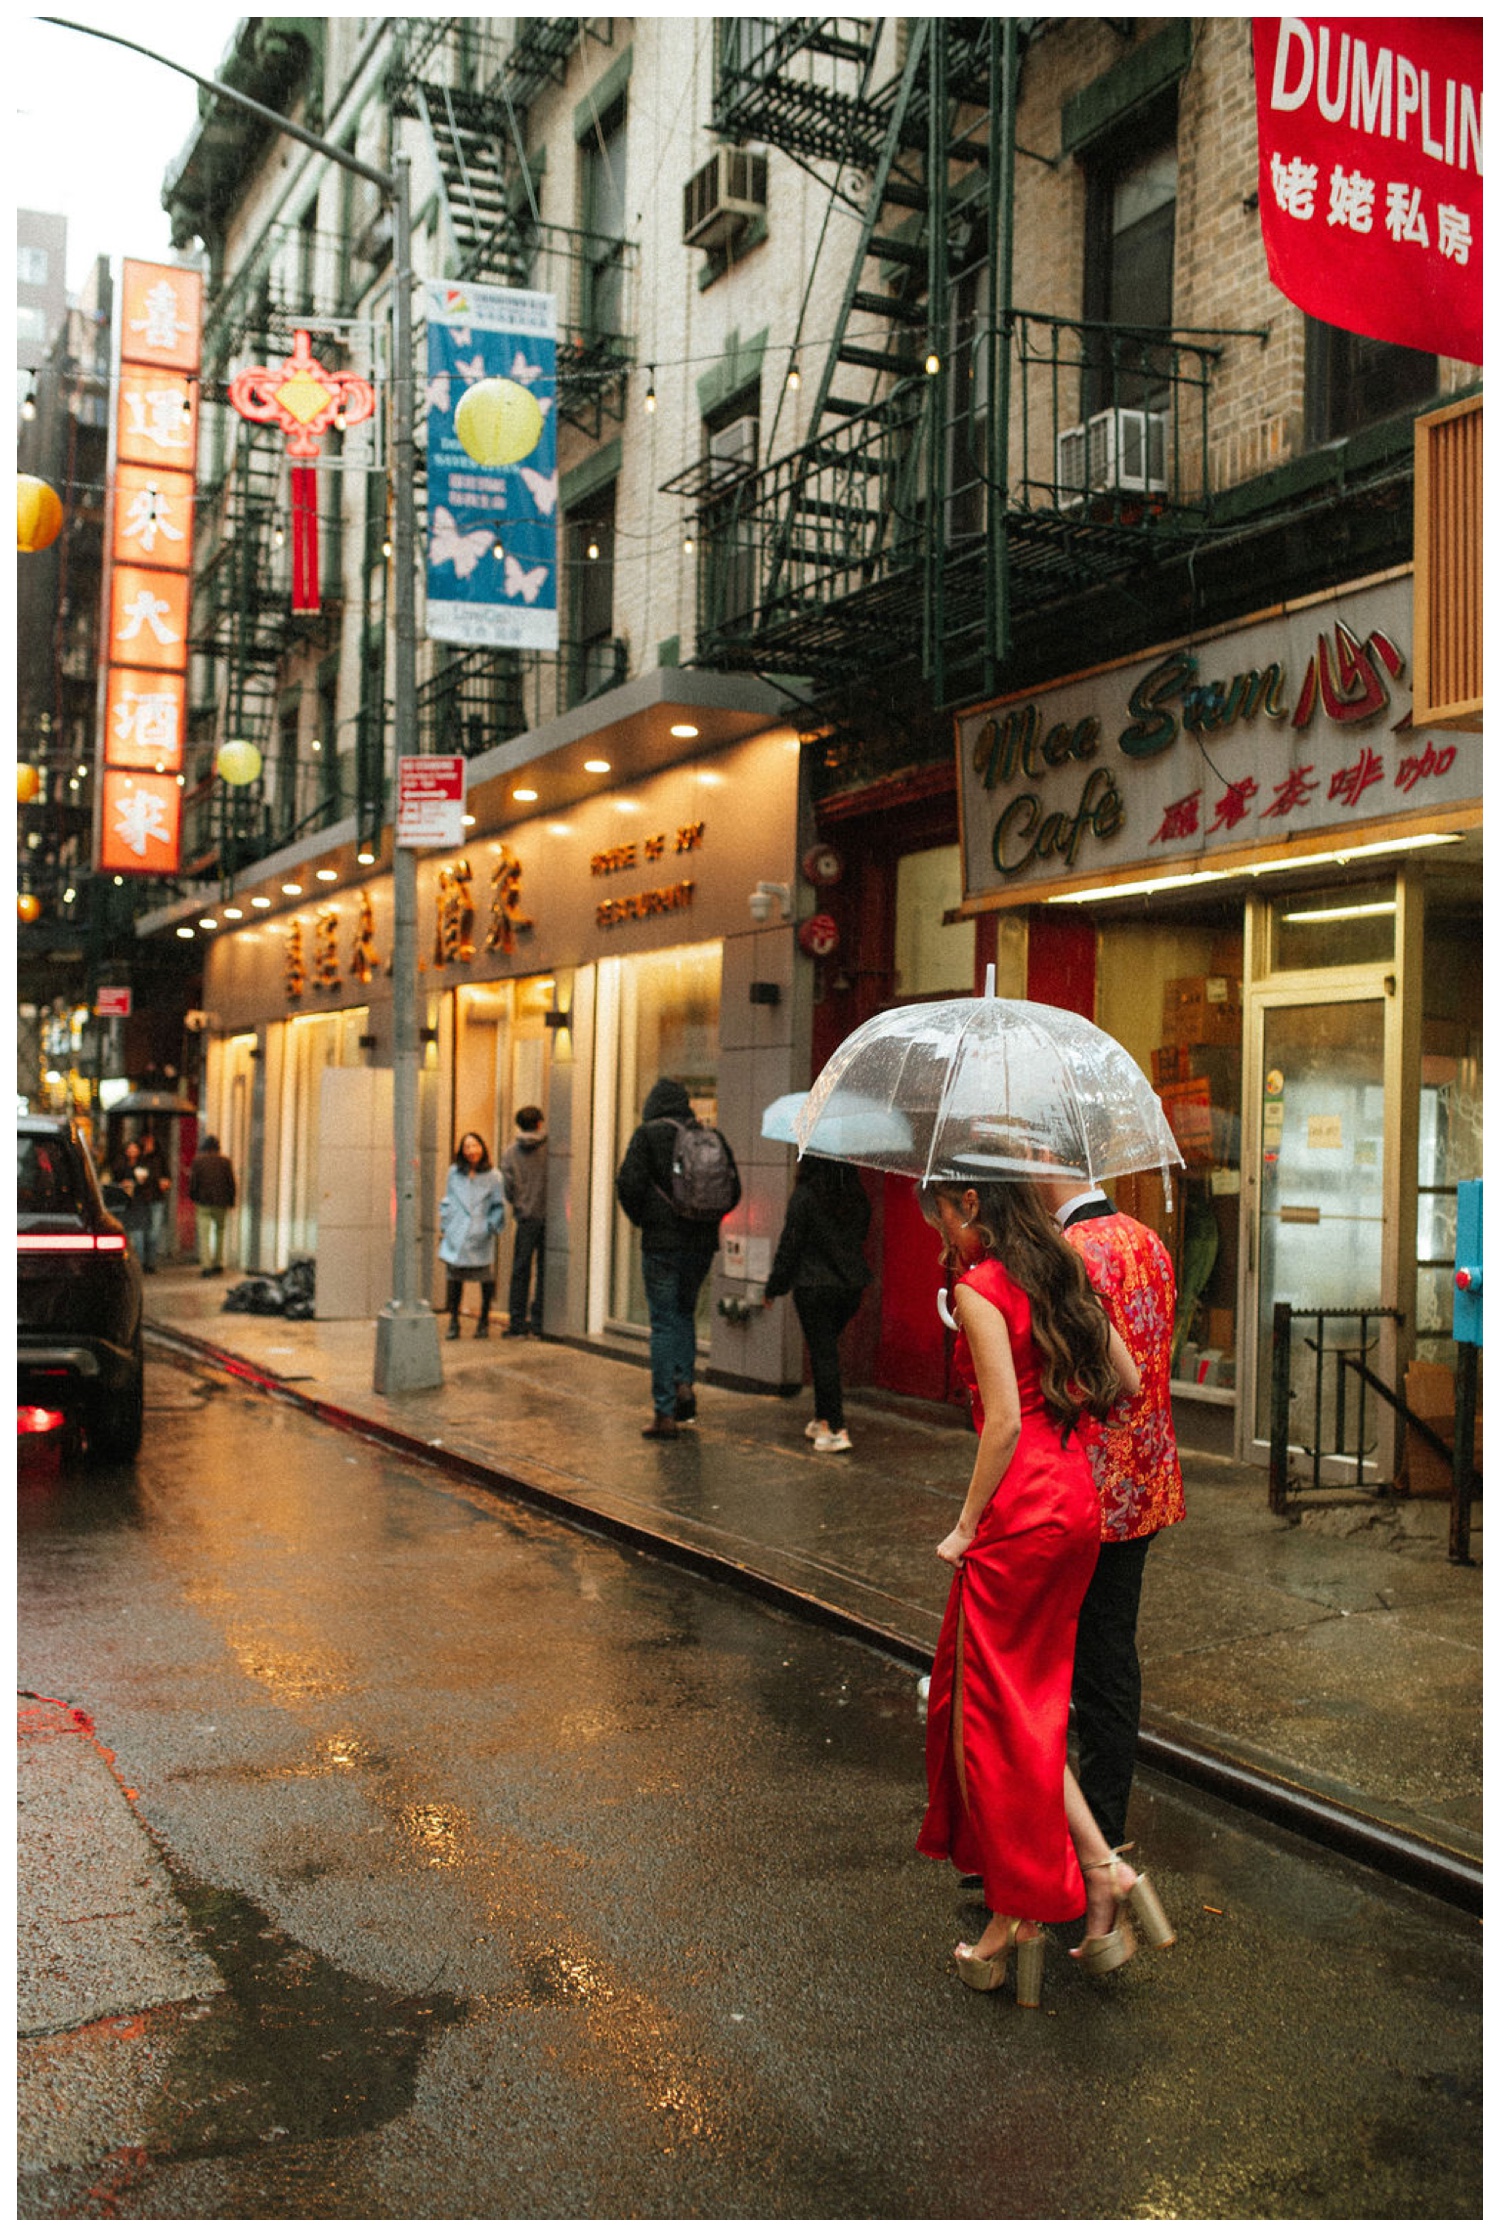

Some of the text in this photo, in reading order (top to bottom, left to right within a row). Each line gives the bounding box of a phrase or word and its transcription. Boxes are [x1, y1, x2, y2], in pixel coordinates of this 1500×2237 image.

[1270, 151, 1473, 266] 姥姥私房
[973, 652, 1288, 791] Mee Sum
